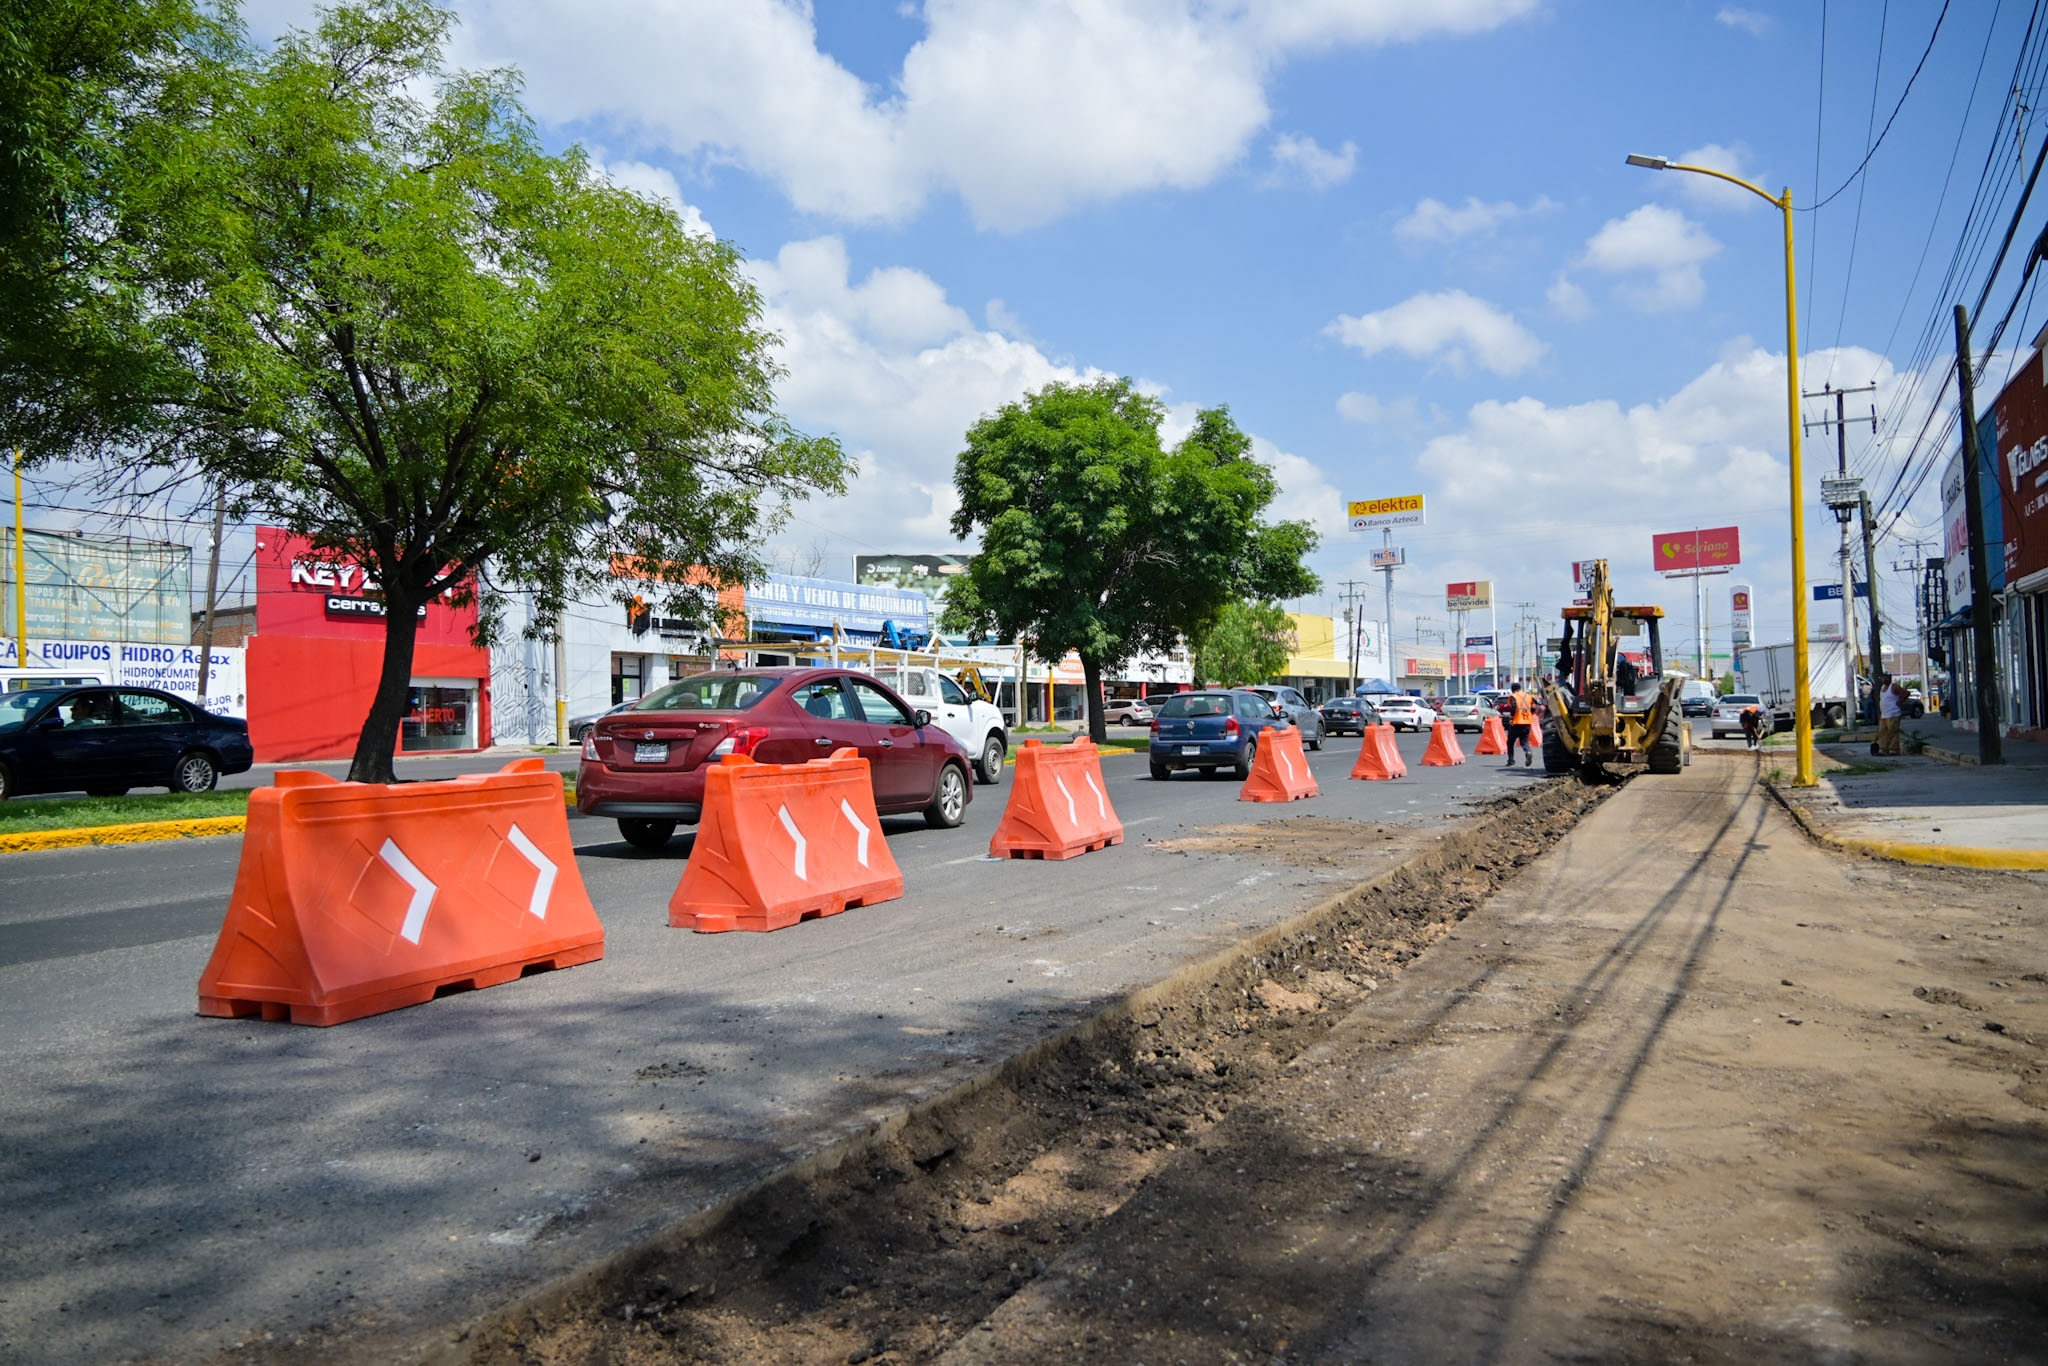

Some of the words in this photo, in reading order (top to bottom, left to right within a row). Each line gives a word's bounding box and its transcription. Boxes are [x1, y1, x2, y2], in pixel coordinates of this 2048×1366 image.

[1369, 498, 1418, 513] elektra
[1368, 519, 1391, 527] Banco
[1392, 516, 1418, 524] Azteca
[1684, 541, 1729, 554] Soriana
[291, 559, 357, 588] KEY
[750, 583, 788, 602] RENTA
[791, 586, 800, 603] Y
[804, 587, 839, 608] VENTA
[843, 592, 857, 610] DE
[859, 594, 924, 617] MAQUINARIA
[1928, 568, 1937, 648] TORNILOS
[43, 643, 111, 661] EQUIPOS
[122, 645, 174, 663] HIDRO
[182, 649, 231, 665] Reax
